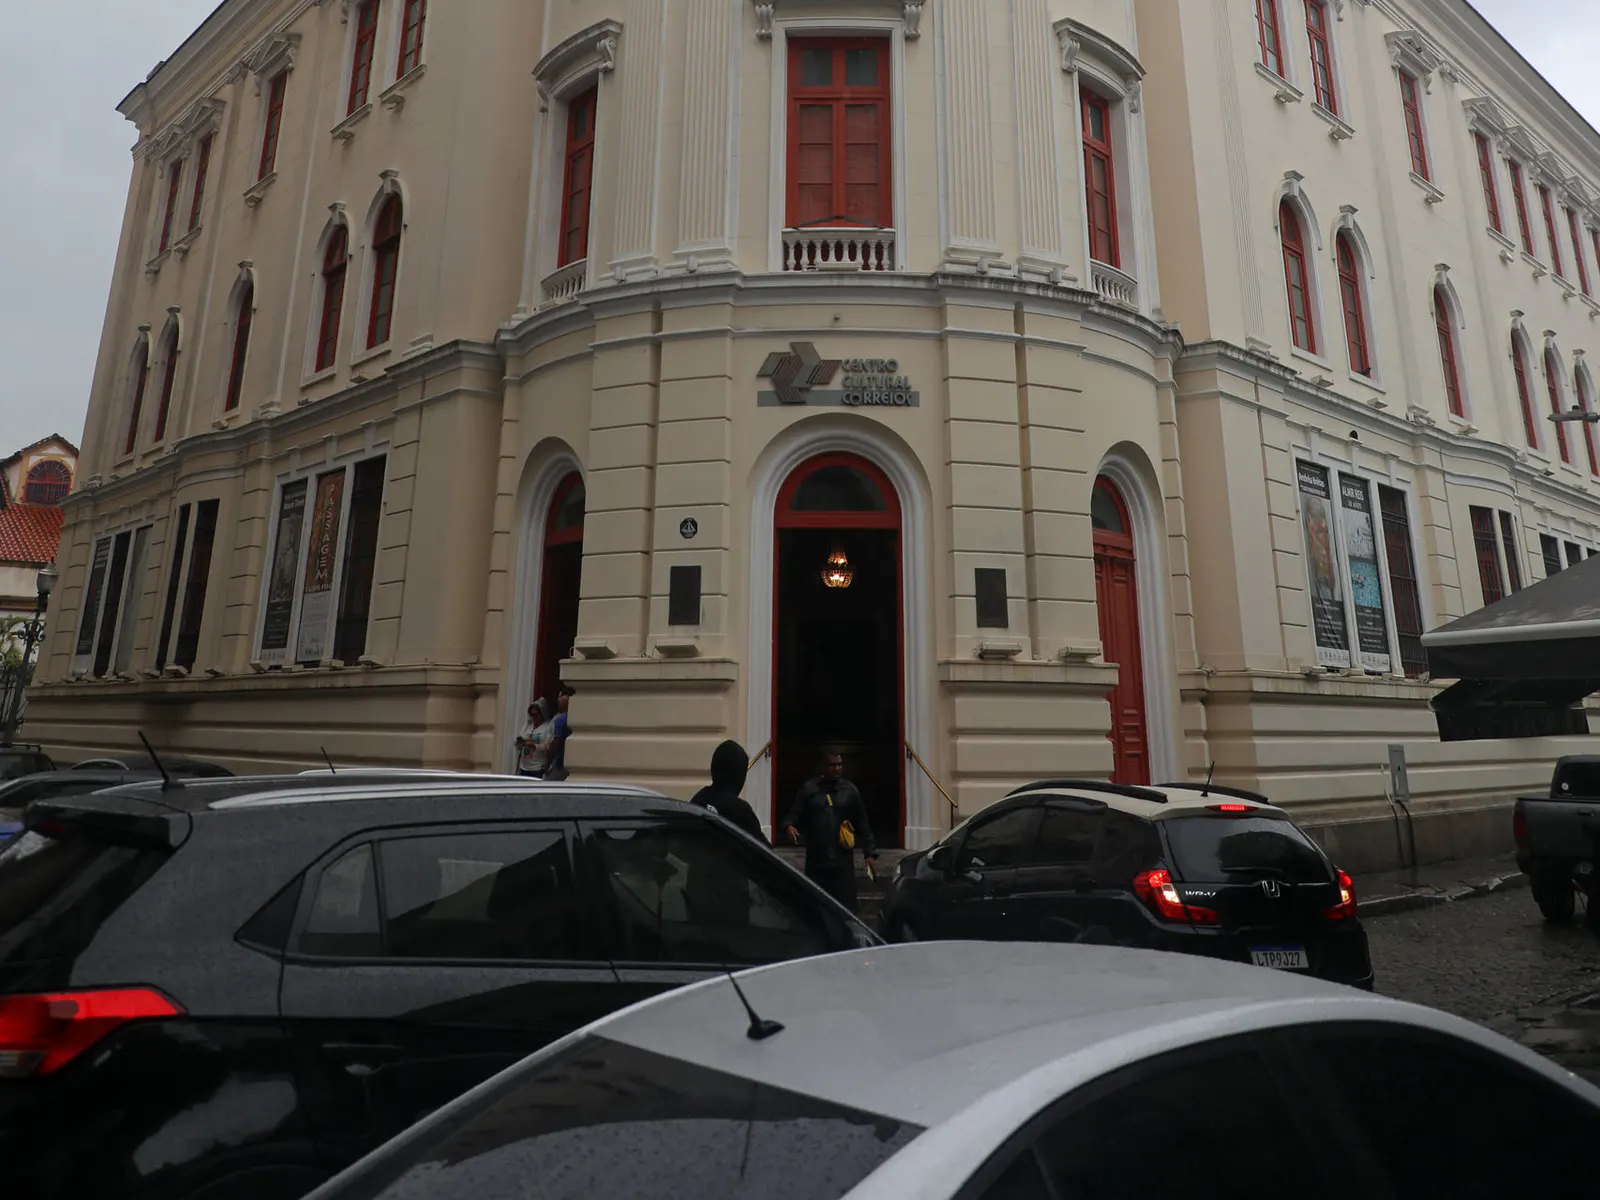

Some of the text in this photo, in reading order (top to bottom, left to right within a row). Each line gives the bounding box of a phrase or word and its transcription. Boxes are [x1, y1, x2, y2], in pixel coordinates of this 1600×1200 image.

[842, 359, 898, 372] CENTRO
[842, 374, 912, 389] CULTURAL
[842, 391, 912, 405] CORREIOS
[315, 483, 335, 580] PASSAGEM
[1256, 951, 1300, 966] LTP9J27
